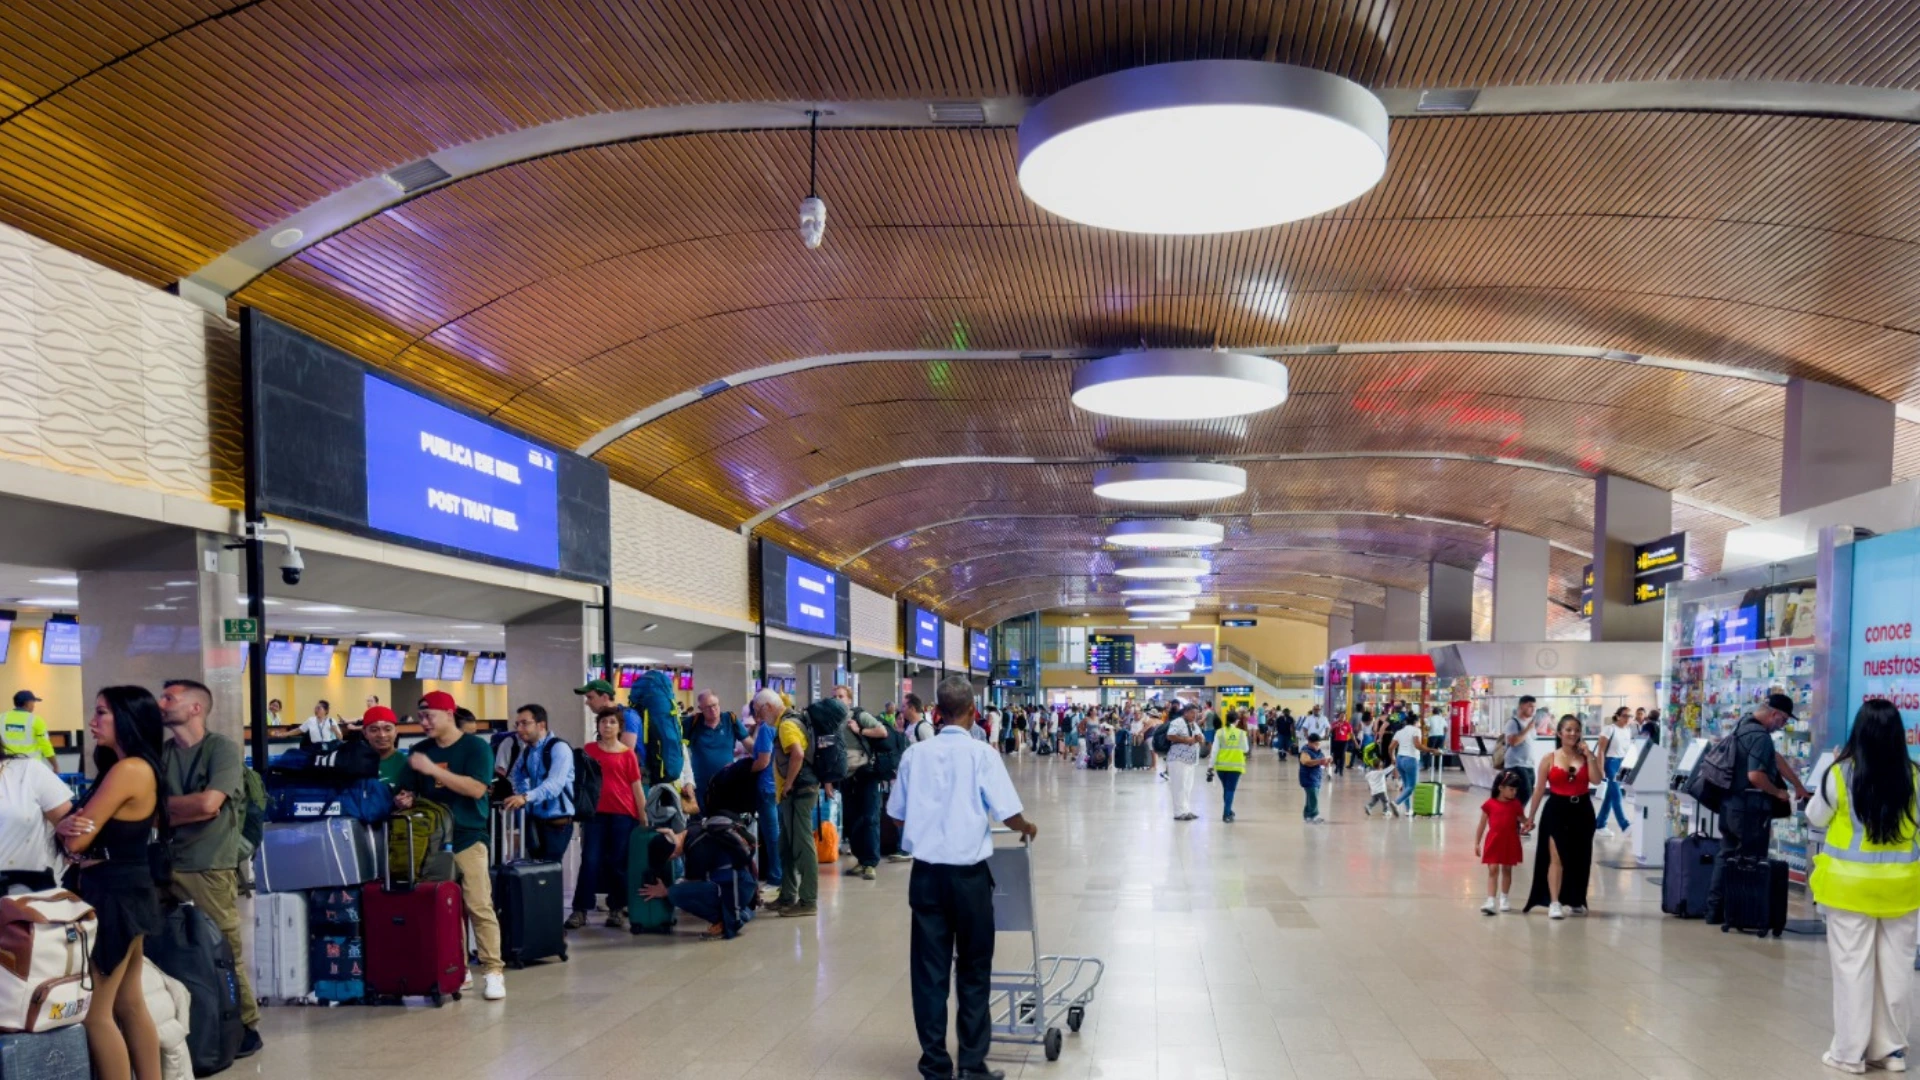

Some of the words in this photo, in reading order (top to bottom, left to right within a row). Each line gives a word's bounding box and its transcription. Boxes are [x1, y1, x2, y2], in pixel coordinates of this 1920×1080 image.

[421, 431, 473, 468] PUBLICA
[428, 488, 460, 515] POST
[461, 498, 491, 524] THAT
[1865, 622, 1912, 643] conoce
[1863, 655, 1920, 677] nuestros
